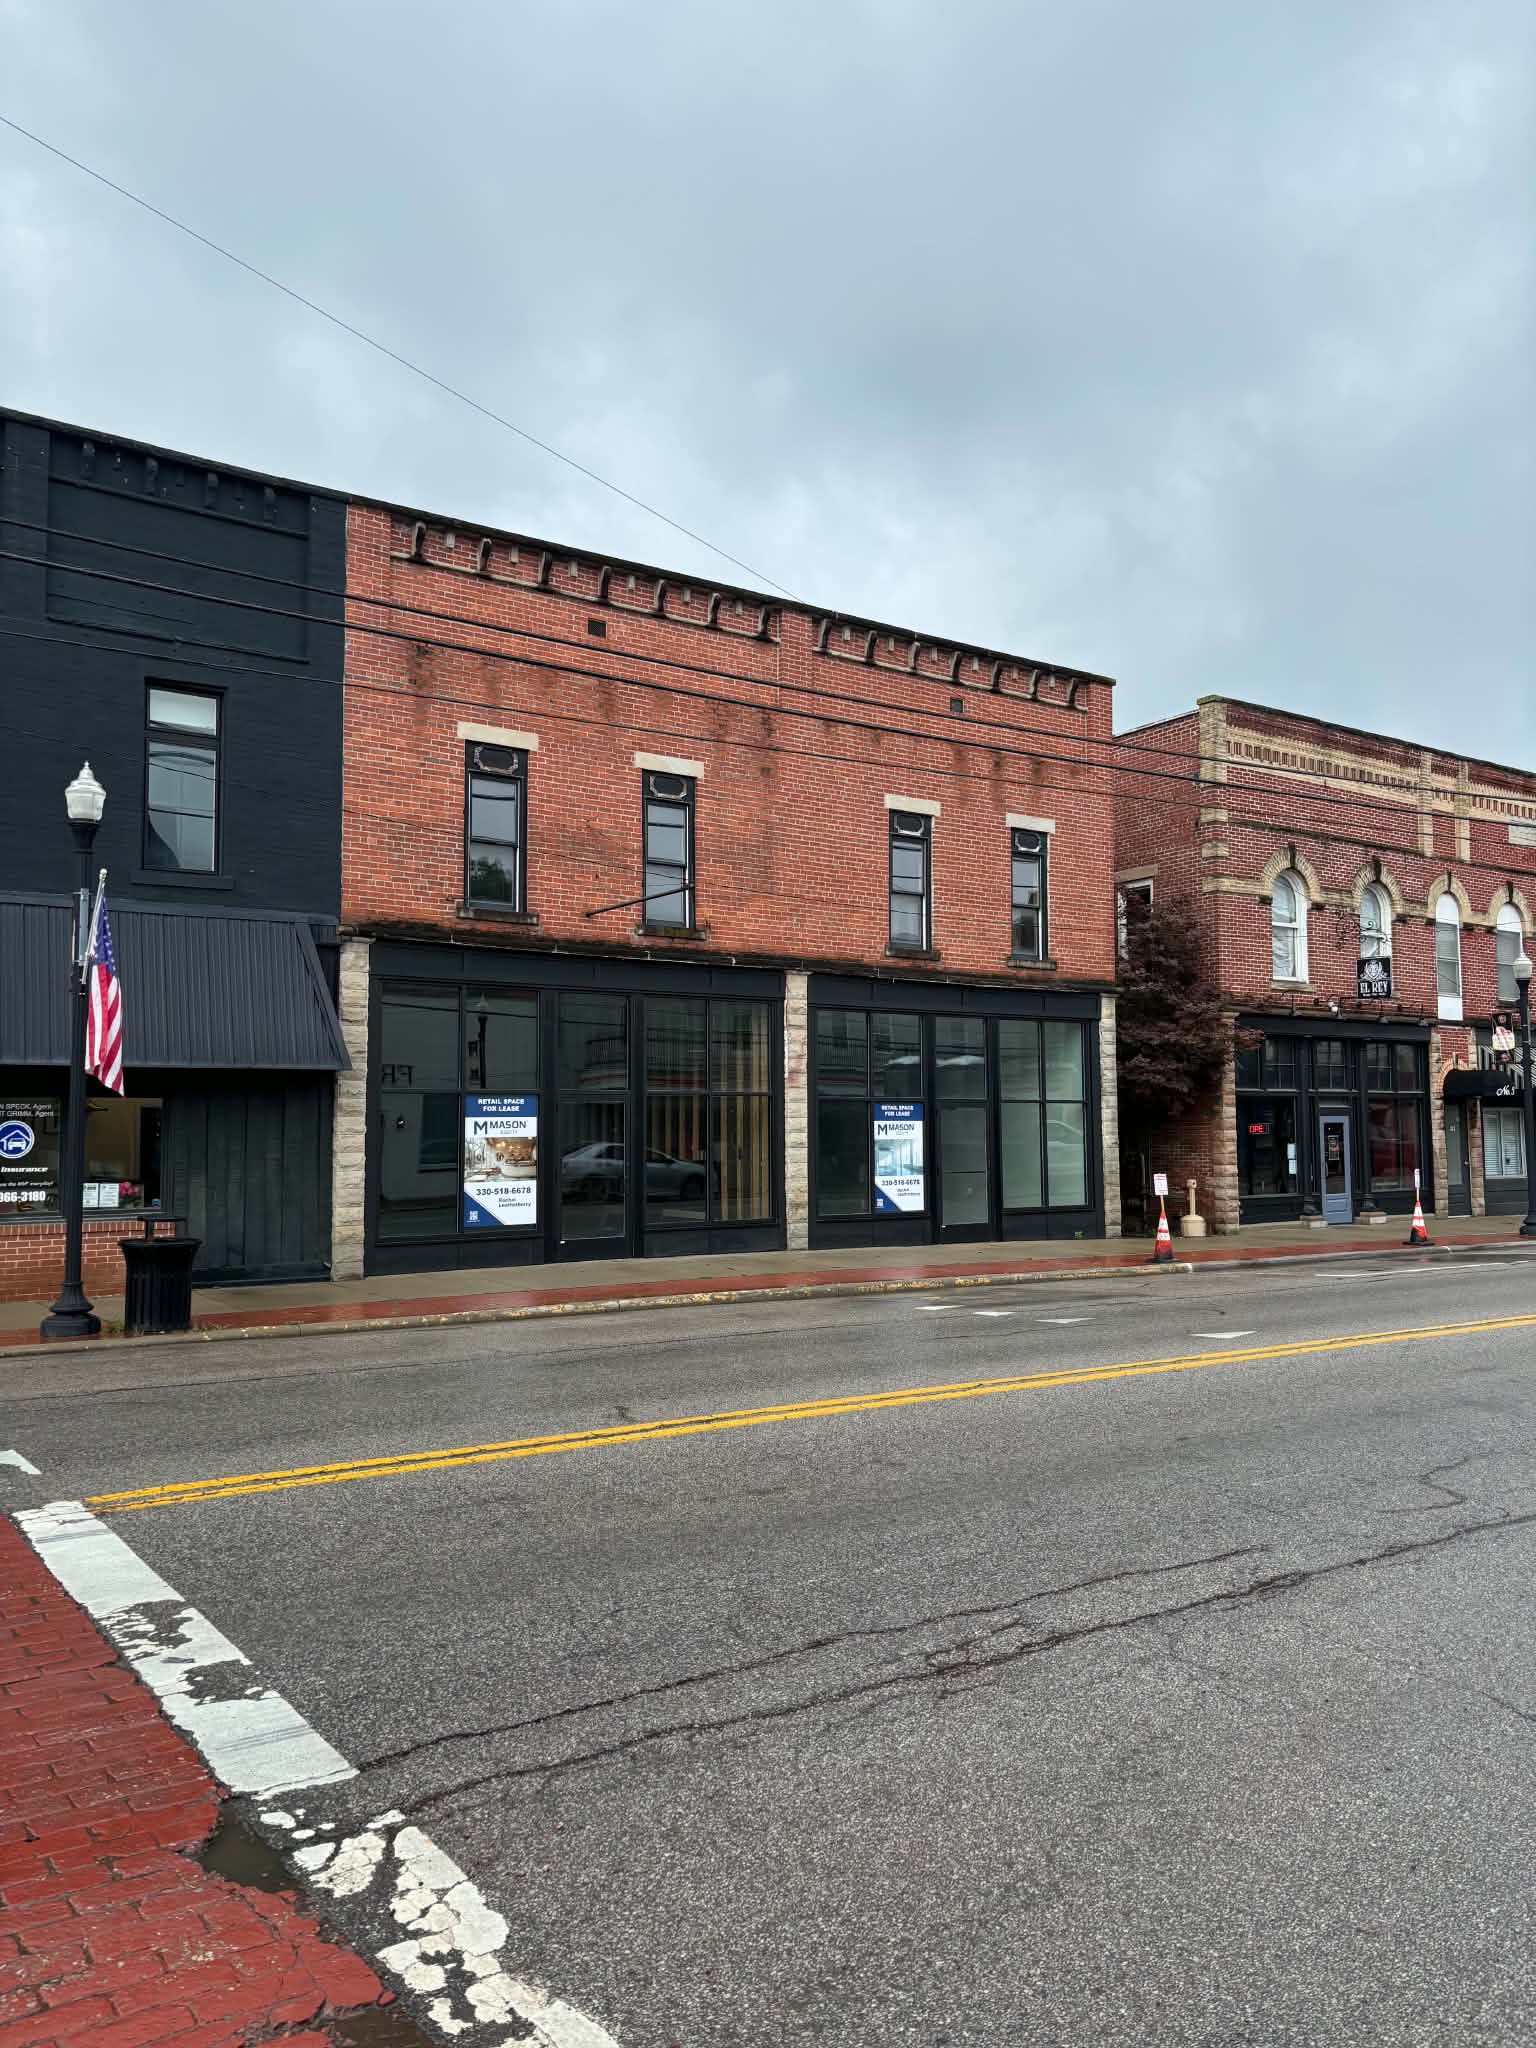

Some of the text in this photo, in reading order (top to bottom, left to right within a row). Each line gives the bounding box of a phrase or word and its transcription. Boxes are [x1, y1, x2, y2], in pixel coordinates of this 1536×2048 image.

[1360, 981, 1388, 993] EL REY
[489, 1121, 527, 1129] MASON
[476, 1186, 532, 1196] 330-518-6678
